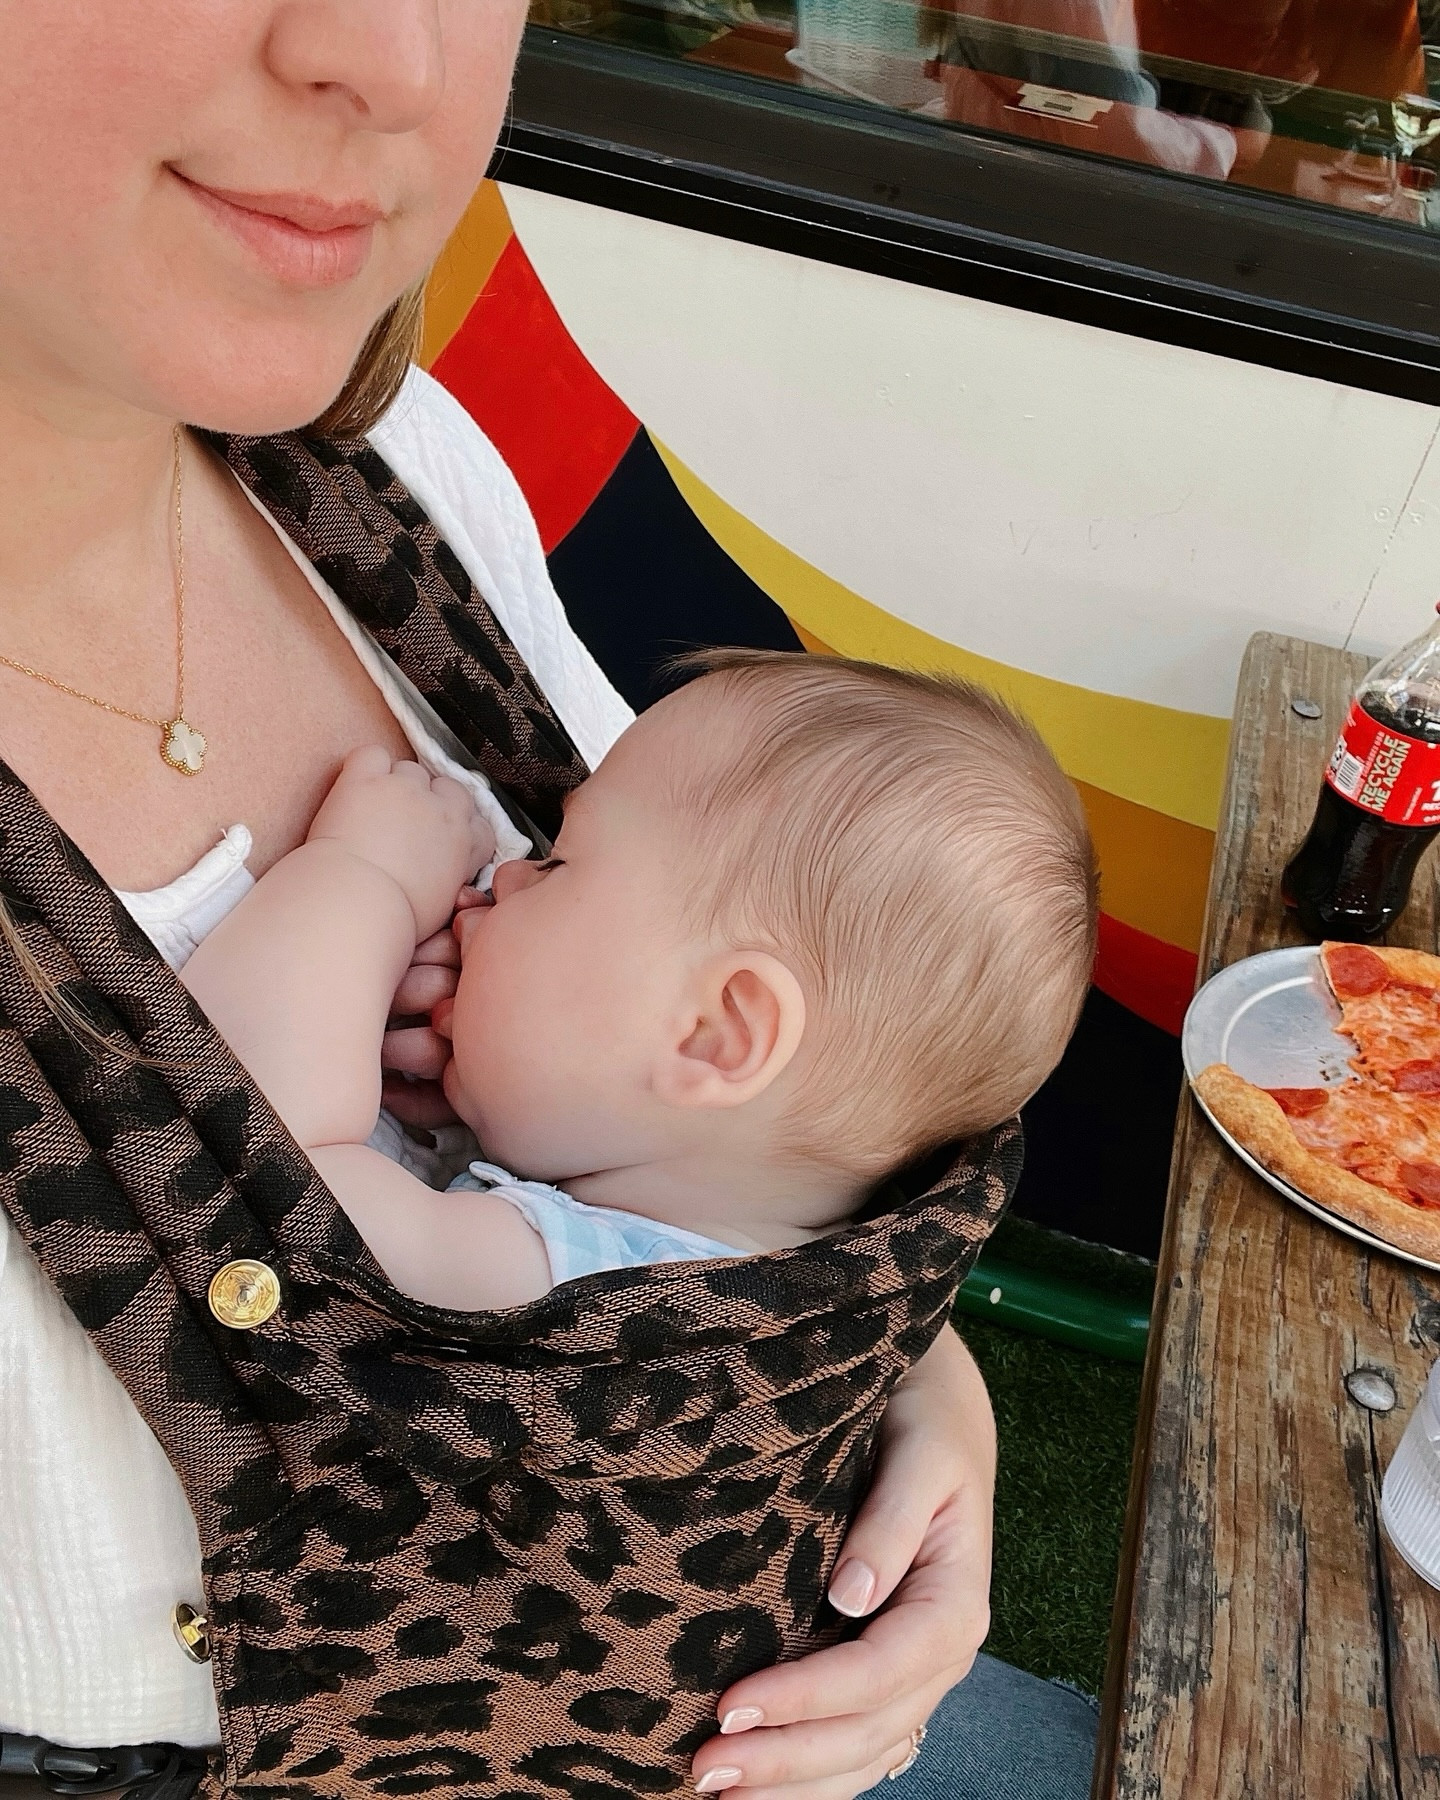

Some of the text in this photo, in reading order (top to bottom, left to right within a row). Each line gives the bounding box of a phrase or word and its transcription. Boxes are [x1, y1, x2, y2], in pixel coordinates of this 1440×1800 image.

[1358, 734, 1399, 807] RECYCLE
[1371, 787, 1391, 812] ME
[1382, 740, 1412, 788] AGAIN
